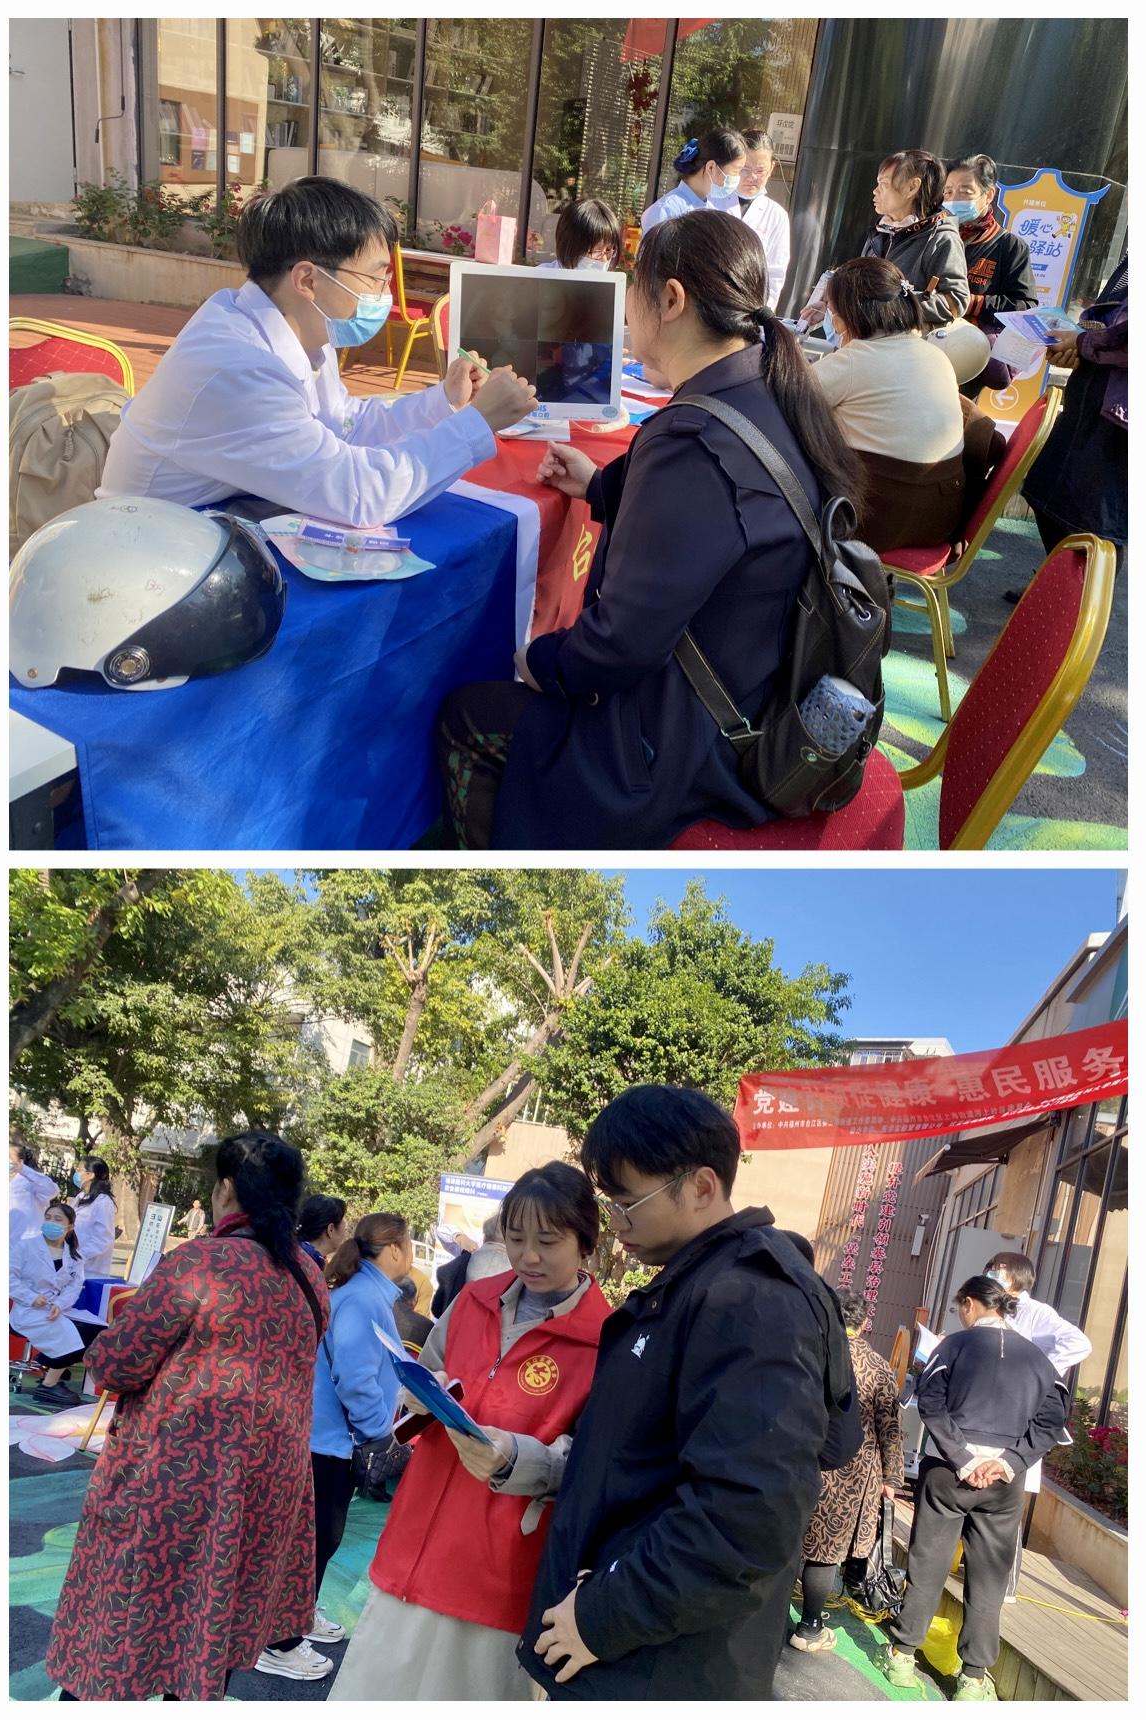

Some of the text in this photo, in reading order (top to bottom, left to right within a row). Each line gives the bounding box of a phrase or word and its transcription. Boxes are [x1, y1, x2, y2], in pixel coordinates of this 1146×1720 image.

[1018, 218, 1054, 237] 暖心
[1029, 240, 1063, 258] 驿站
[956, 1045, 1125, 1103] 惠民服务
